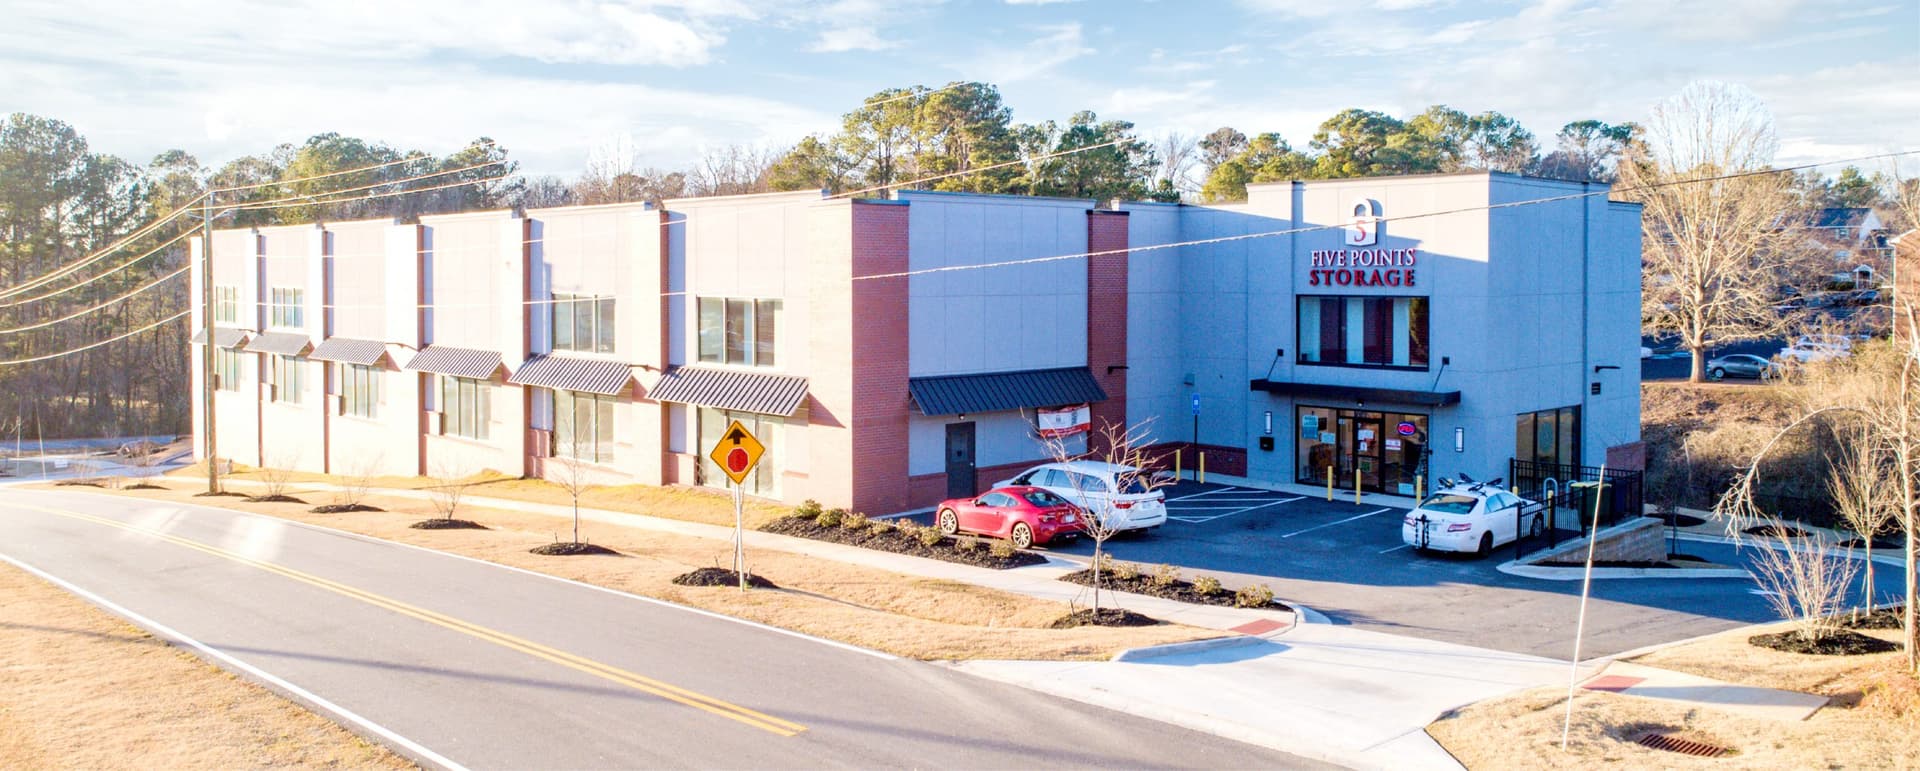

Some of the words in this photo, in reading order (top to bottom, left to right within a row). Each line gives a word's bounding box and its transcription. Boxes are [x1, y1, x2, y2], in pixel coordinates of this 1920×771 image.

[1311, 249, 1346, 267] FIVE
[1350, 248, 1416, 267] POINTS
[1309, 269, 1415, 287] STORAGE
